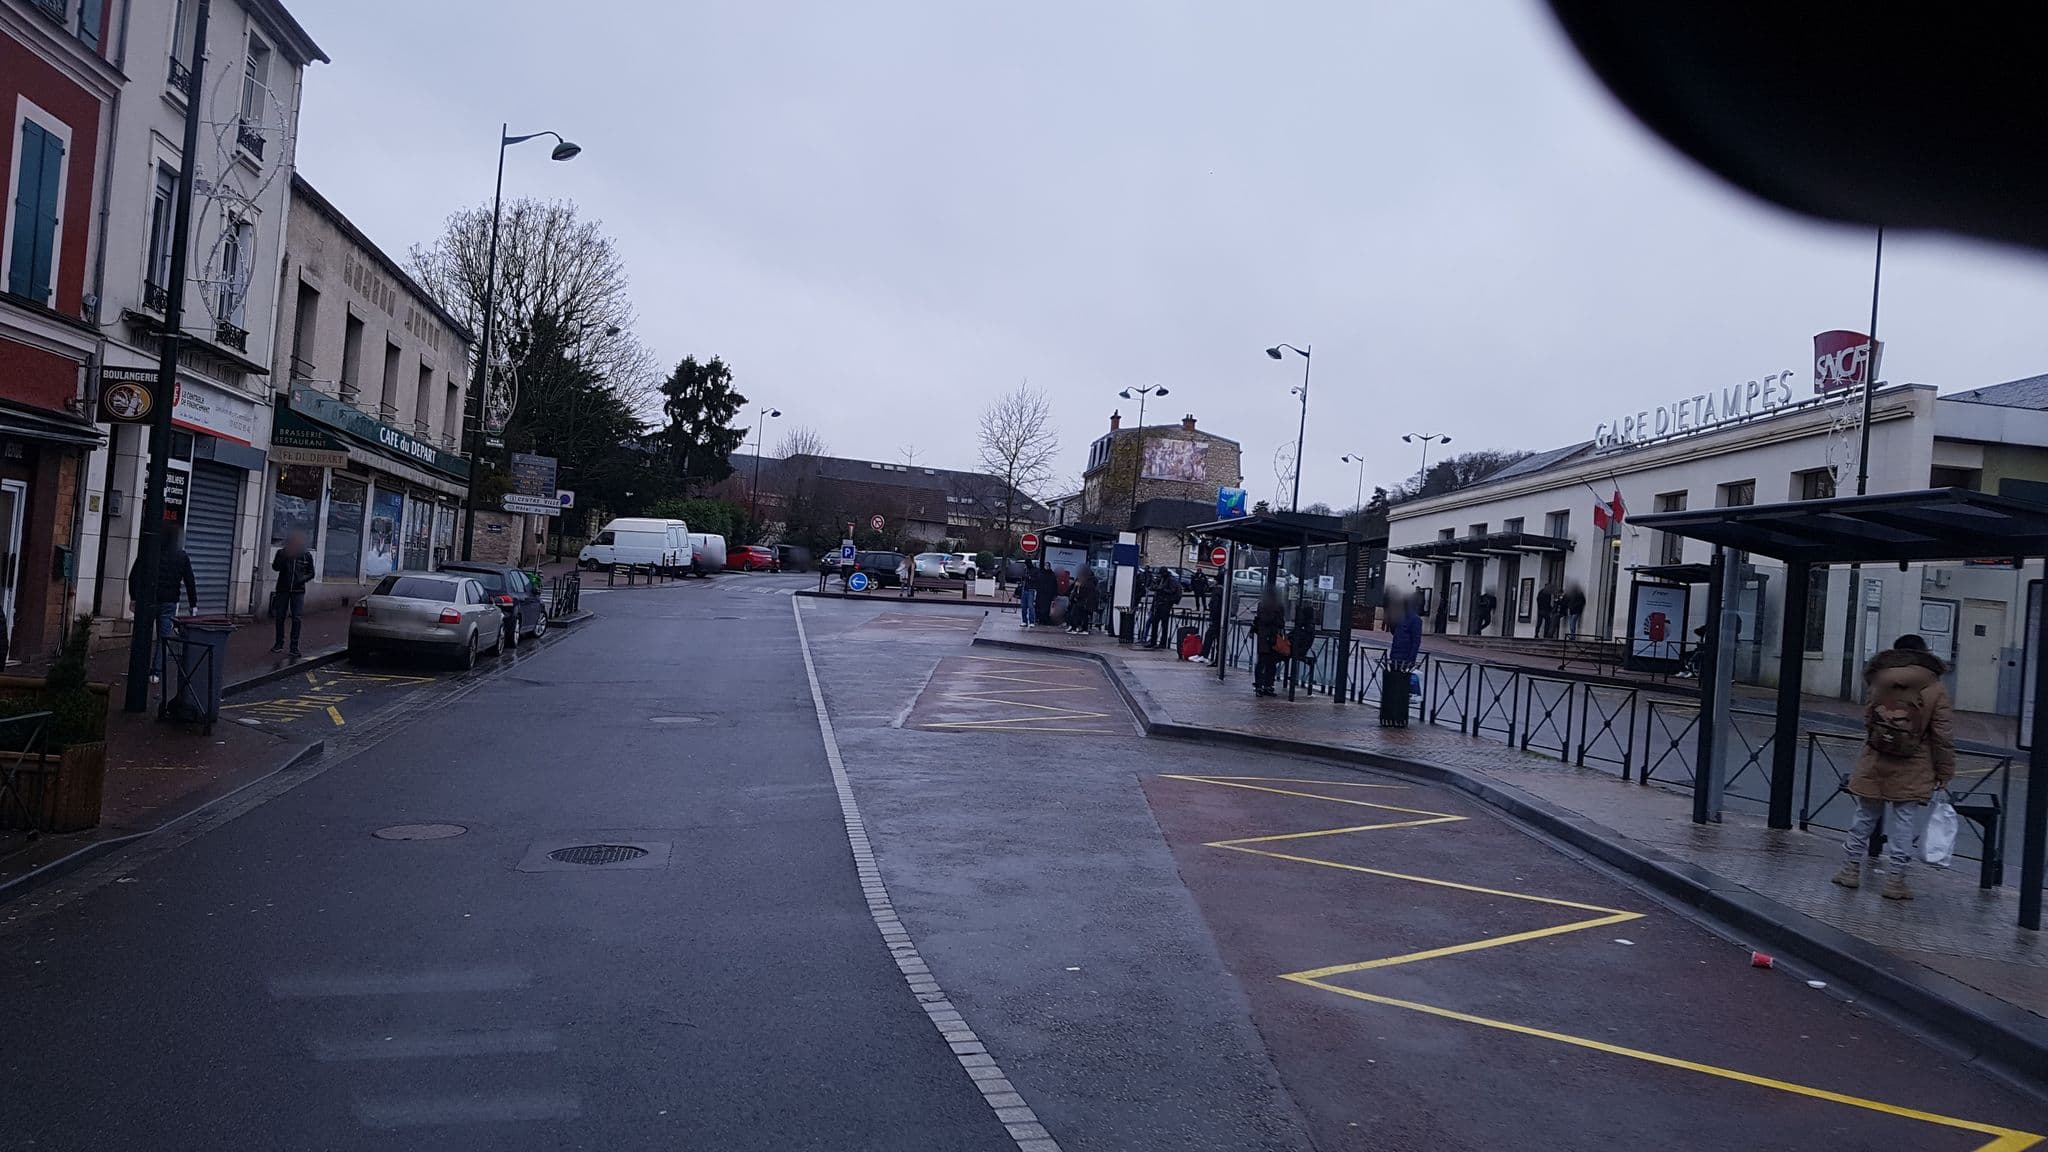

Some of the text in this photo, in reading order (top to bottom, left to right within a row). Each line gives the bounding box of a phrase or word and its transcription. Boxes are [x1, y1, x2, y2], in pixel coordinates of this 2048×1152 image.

[1816, 344, 1871, 379] SNCF
[103, 369, 159, 383] BOULANGERIE
[1595, 369, 1795, 449] GARE D'ETAMPES
[279, 428, 323, 439] BRASSERIE
[380, 427, 399, 447] CAFE
[411, 440, 437, 464] DEPART
[517, 496, 540, 504] CENTRE
[844, 547, 851, 557] P
